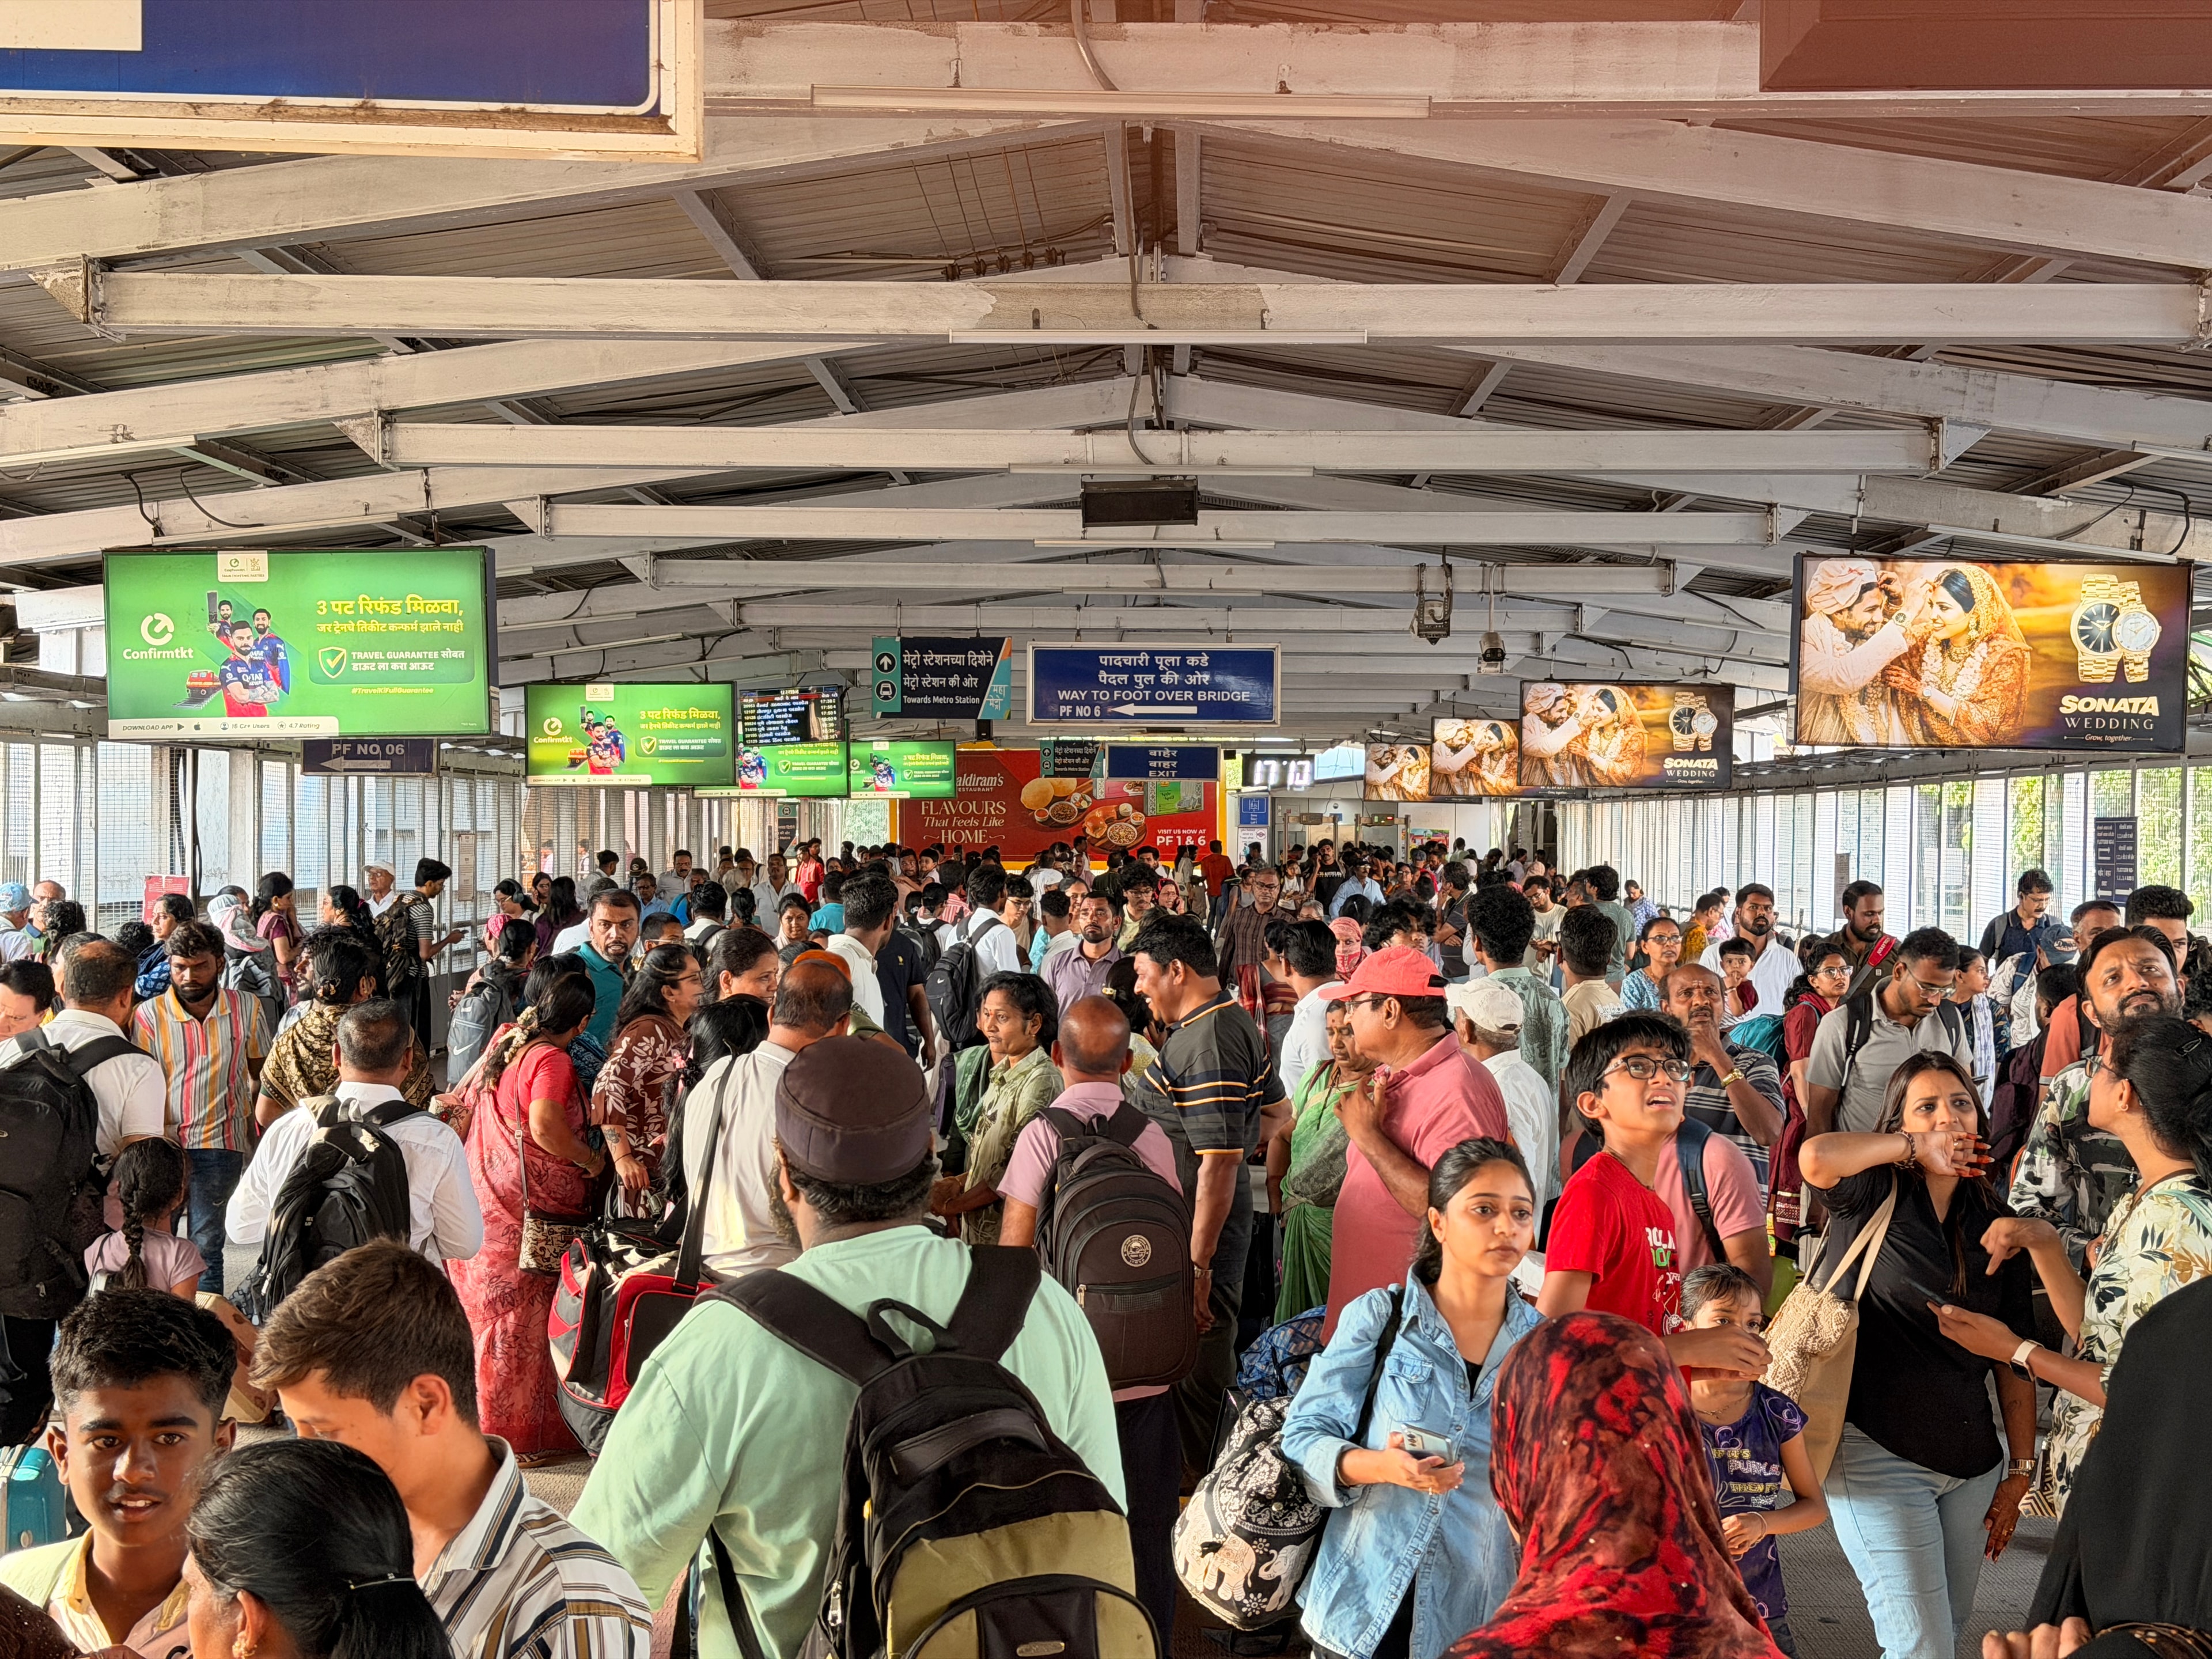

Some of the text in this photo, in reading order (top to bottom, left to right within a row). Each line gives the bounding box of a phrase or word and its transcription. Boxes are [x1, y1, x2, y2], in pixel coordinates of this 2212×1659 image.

[316, 600, 327, 615] 3
[330, 600, 355, 615] पट
[358, 594, 403, 616] रिफंड
[123, 646, 194, 660] Confirmtkt
[351, 652, 384, 660] TRAVEL
[387, 651, 439, 659] GUARANTEE
[903, 650, 994, 669] मेट्रो स्टेशनच्या दिशेने
[1099, 652, 1209, 671] पादचारी पूला कडे
[903, 673, 979, 690] मेट्रो स्टेशन की ओर
[1099, 670, 1210, 689] पैदल पुल की ओर
[903, 696, 979, 704] Towards Metro Station
[1058, 690, 1251, 702] WAY TO FOOT OVER BRIDGE
[1059, 705, 1101, 717] PF NO 6
[2059, 695, 2160, 717] SONATA
[2065, 718, 2154, 730] WEDDING
[332, 744, 405, 755] PF NO 06
[1149, 748, 1178, 757] बाहेर
[1663, 757, 1718, 770] SONATA
[957, 773, 1003, 786] aldiram's
[922, 801, 1006, 815] FLAVOURS
[924, 817, 1004, 827] That Feels Like
[941, 830, 987, 843] HOME
[1156, 836, 1206, 846] PF 1 & 6
